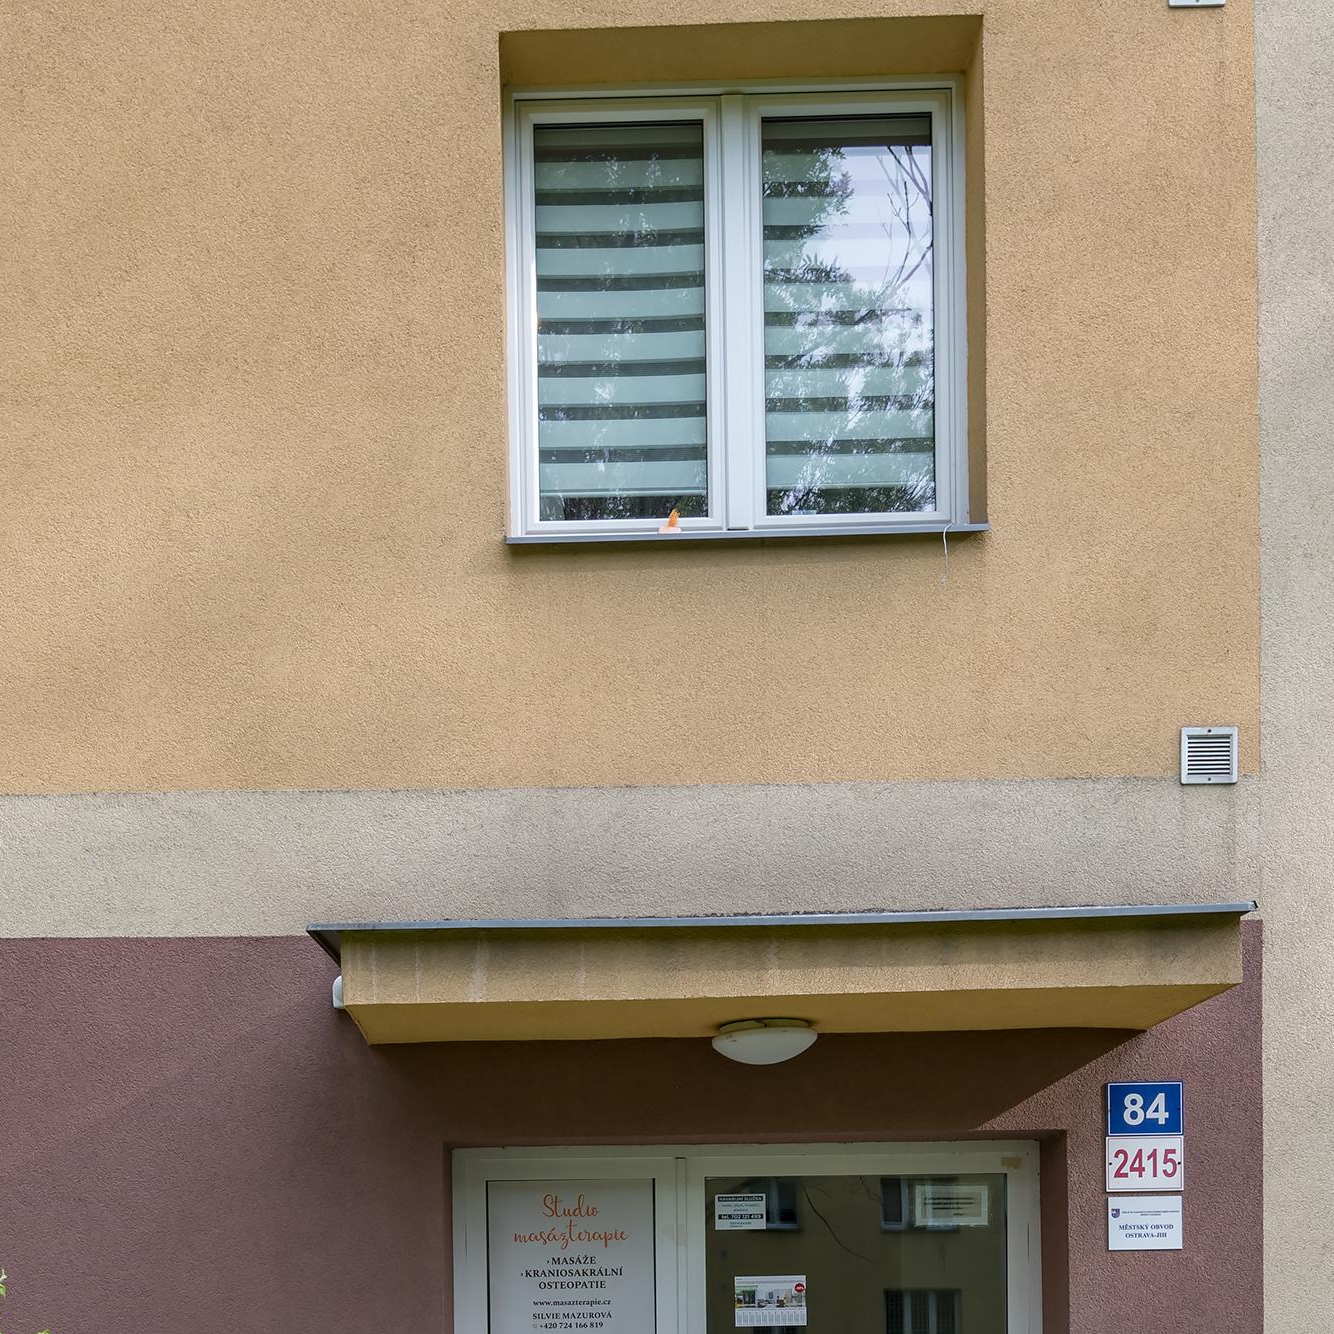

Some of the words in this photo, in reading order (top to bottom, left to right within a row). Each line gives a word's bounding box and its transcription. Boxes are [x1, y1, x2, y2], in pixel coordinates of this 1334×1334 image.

[1123, 1093, 1169, 1125] 84
[1114, 1149, 1177, 1178] 2415
[542, 1193, 599, 1218] Studio
[551, 1255, 596, 1264] MASÁŽE
[525, 1266, 623, 1277] KRANIOSAKRÁLNÍ
[539, 1281, 606, 1289] OSTEOPATIE
[533, 1298, 611, 1306] www.masazterapie.cz
[533, 1312, 560, 1320] SILVIE
[562, 1310, 612, 1319] MAZUROVÁ
